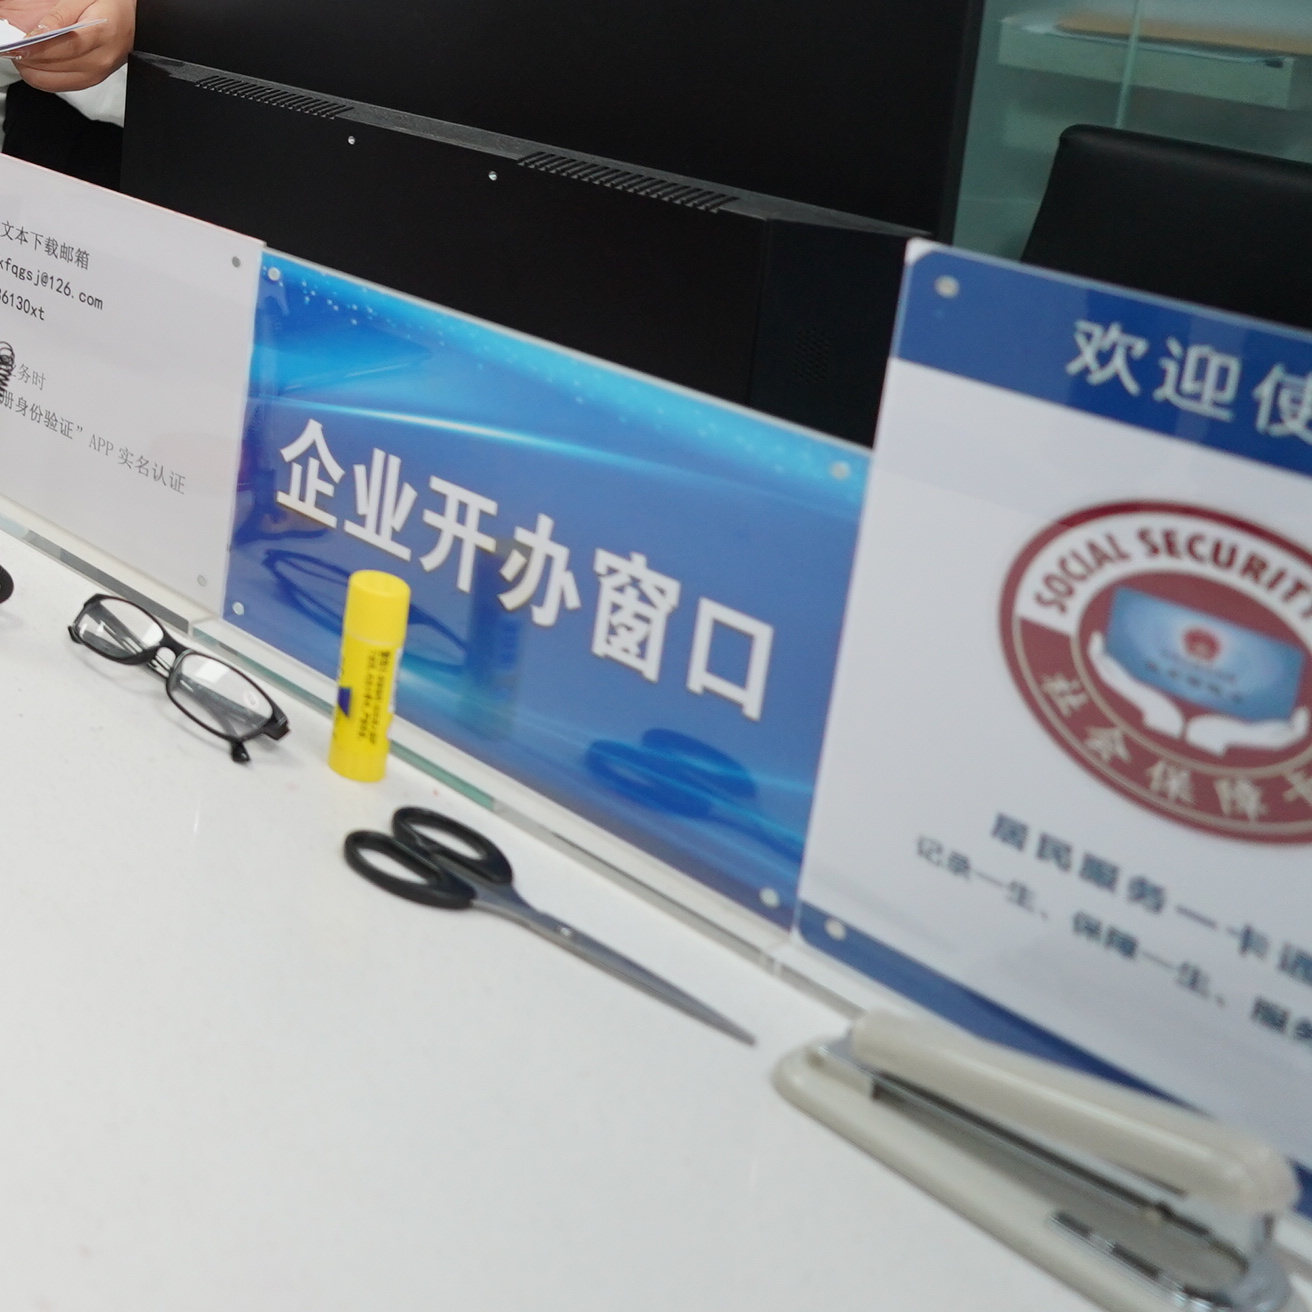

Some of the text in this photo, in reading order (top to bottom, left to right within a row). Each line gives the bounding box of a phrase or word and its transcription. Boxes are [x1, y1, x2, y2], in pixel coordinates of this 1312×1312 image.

[88, 433, 115, 457] APP
[117, 446, 187, 495] 实名认证
[277, 418, 774, 721] 企业开办窗口
[1034, 532, 1131, 614] SOCIAL
